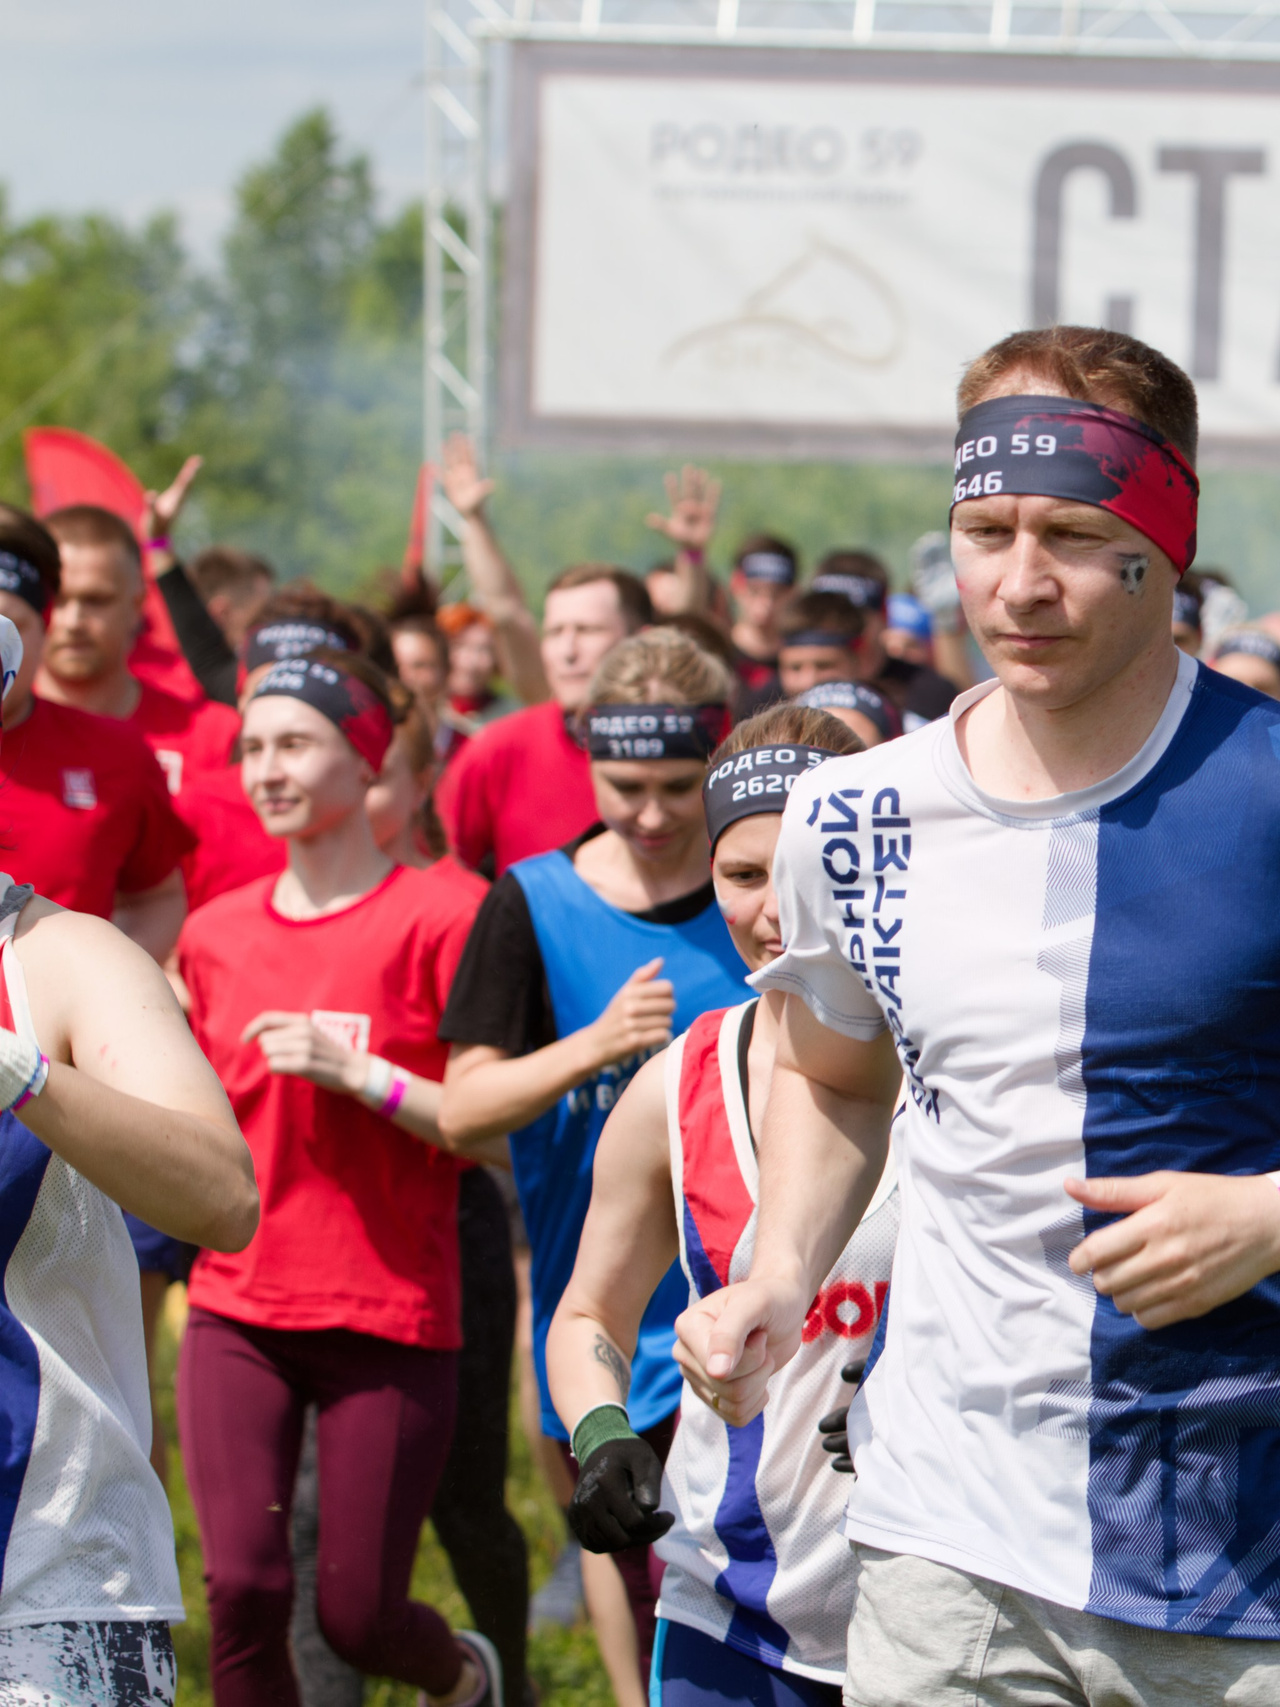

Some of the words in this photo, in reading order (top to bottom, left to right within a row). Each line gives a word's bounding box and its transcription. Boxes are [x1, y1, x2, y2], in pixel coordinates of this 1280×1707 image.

[650, 121, 846, 178] РОДЕО
[861, 126, 925, 178] 59
[954, 435, 998, 475] ДЕО
[1010, 433, 1057, 456] 59
[950, 470, 1003, 507] 646
[589, 714, 659, 737] РОДЕО
[663, 714, 693, 734] 59
[708, 748, 797, 790] РОДЕО
[807, 751, 833, 768] 5
